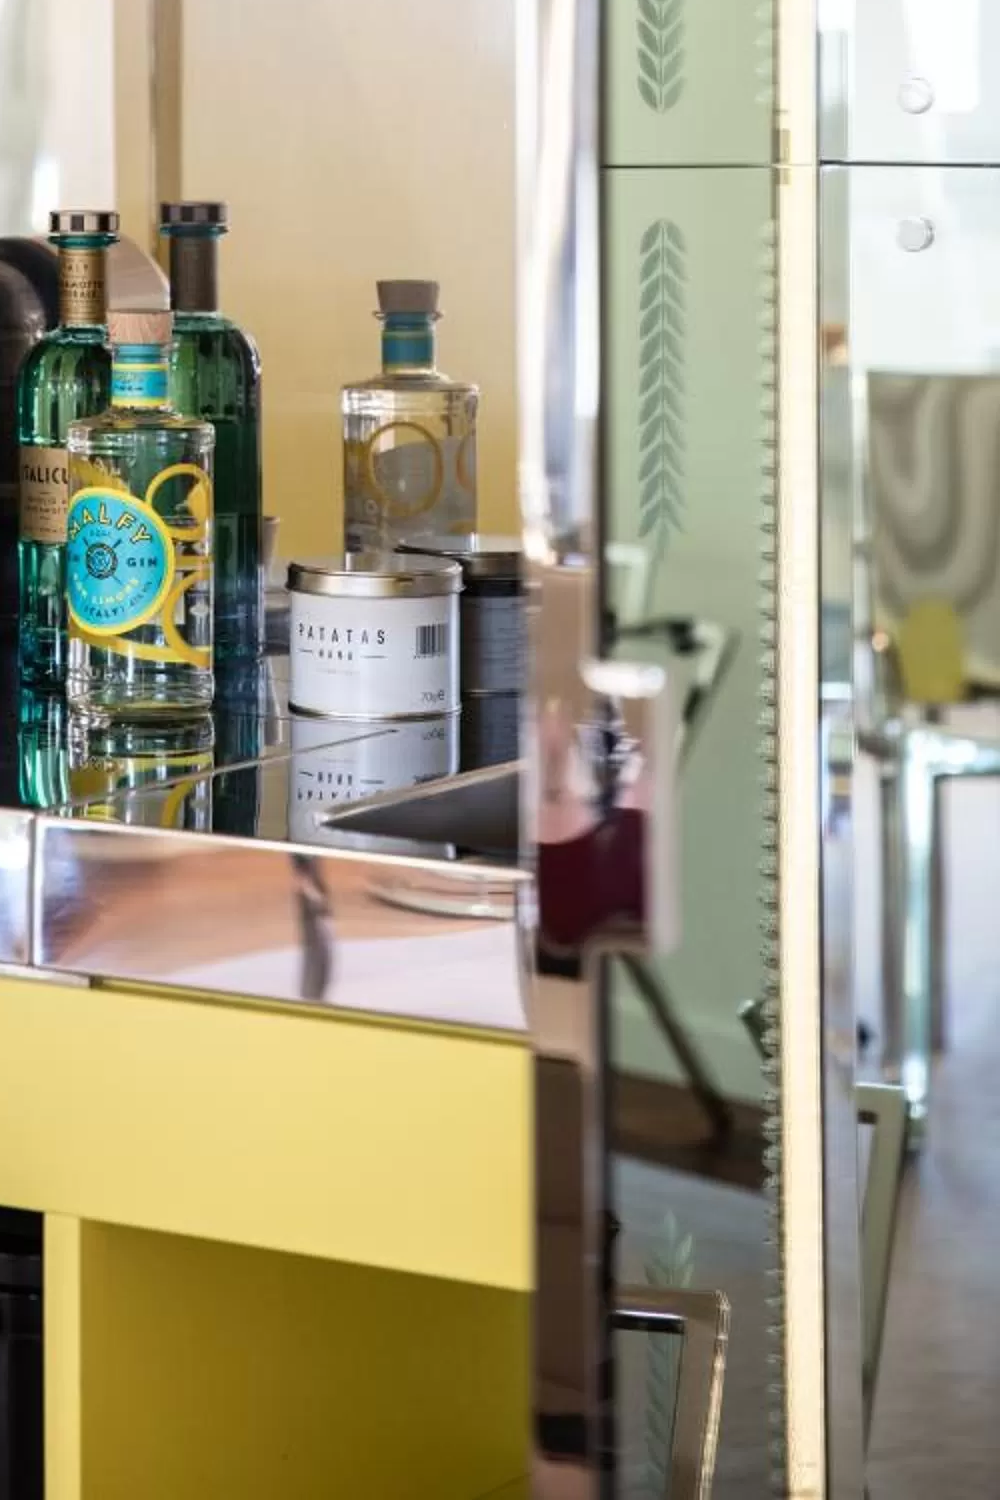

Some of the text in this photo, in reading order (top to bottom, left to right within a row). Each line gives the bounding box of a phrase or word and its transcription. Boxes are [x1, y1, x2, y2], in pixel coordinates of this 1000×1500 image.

[69, 501, 152, 544] MALFY
[126, 557, 158, 569] GIN
[299, 622, 386, 645] PATATAS
